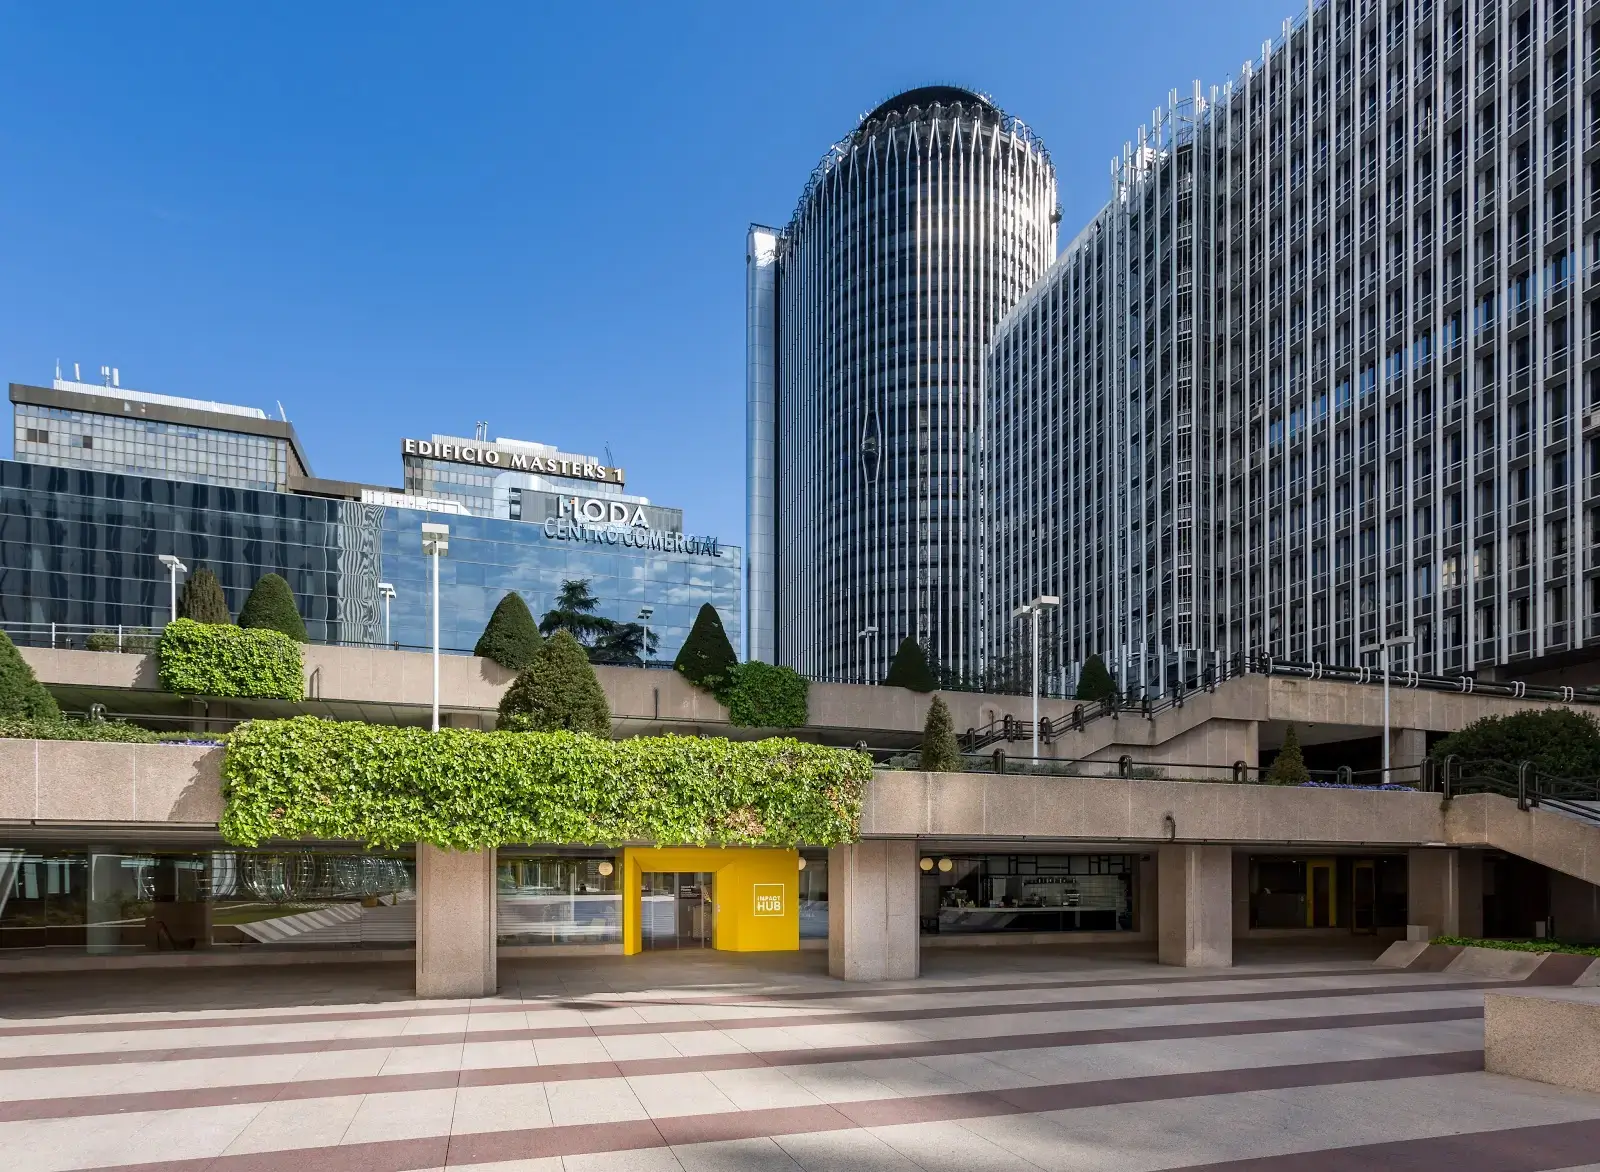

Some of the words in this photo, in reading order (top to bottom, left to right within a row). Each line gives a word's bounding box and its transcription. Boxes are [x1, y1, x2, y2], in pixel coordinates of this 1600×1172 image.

[404, 438, 500, 464] EDIFICIO
[613, 468, 622, 481] 1
[558, 495, 649, 528] MODA
[544, 516, 619, 545] CENTRO
[623, 524, 721, 557] COMERCIAL
[757, 901, 781, 911] HUB
